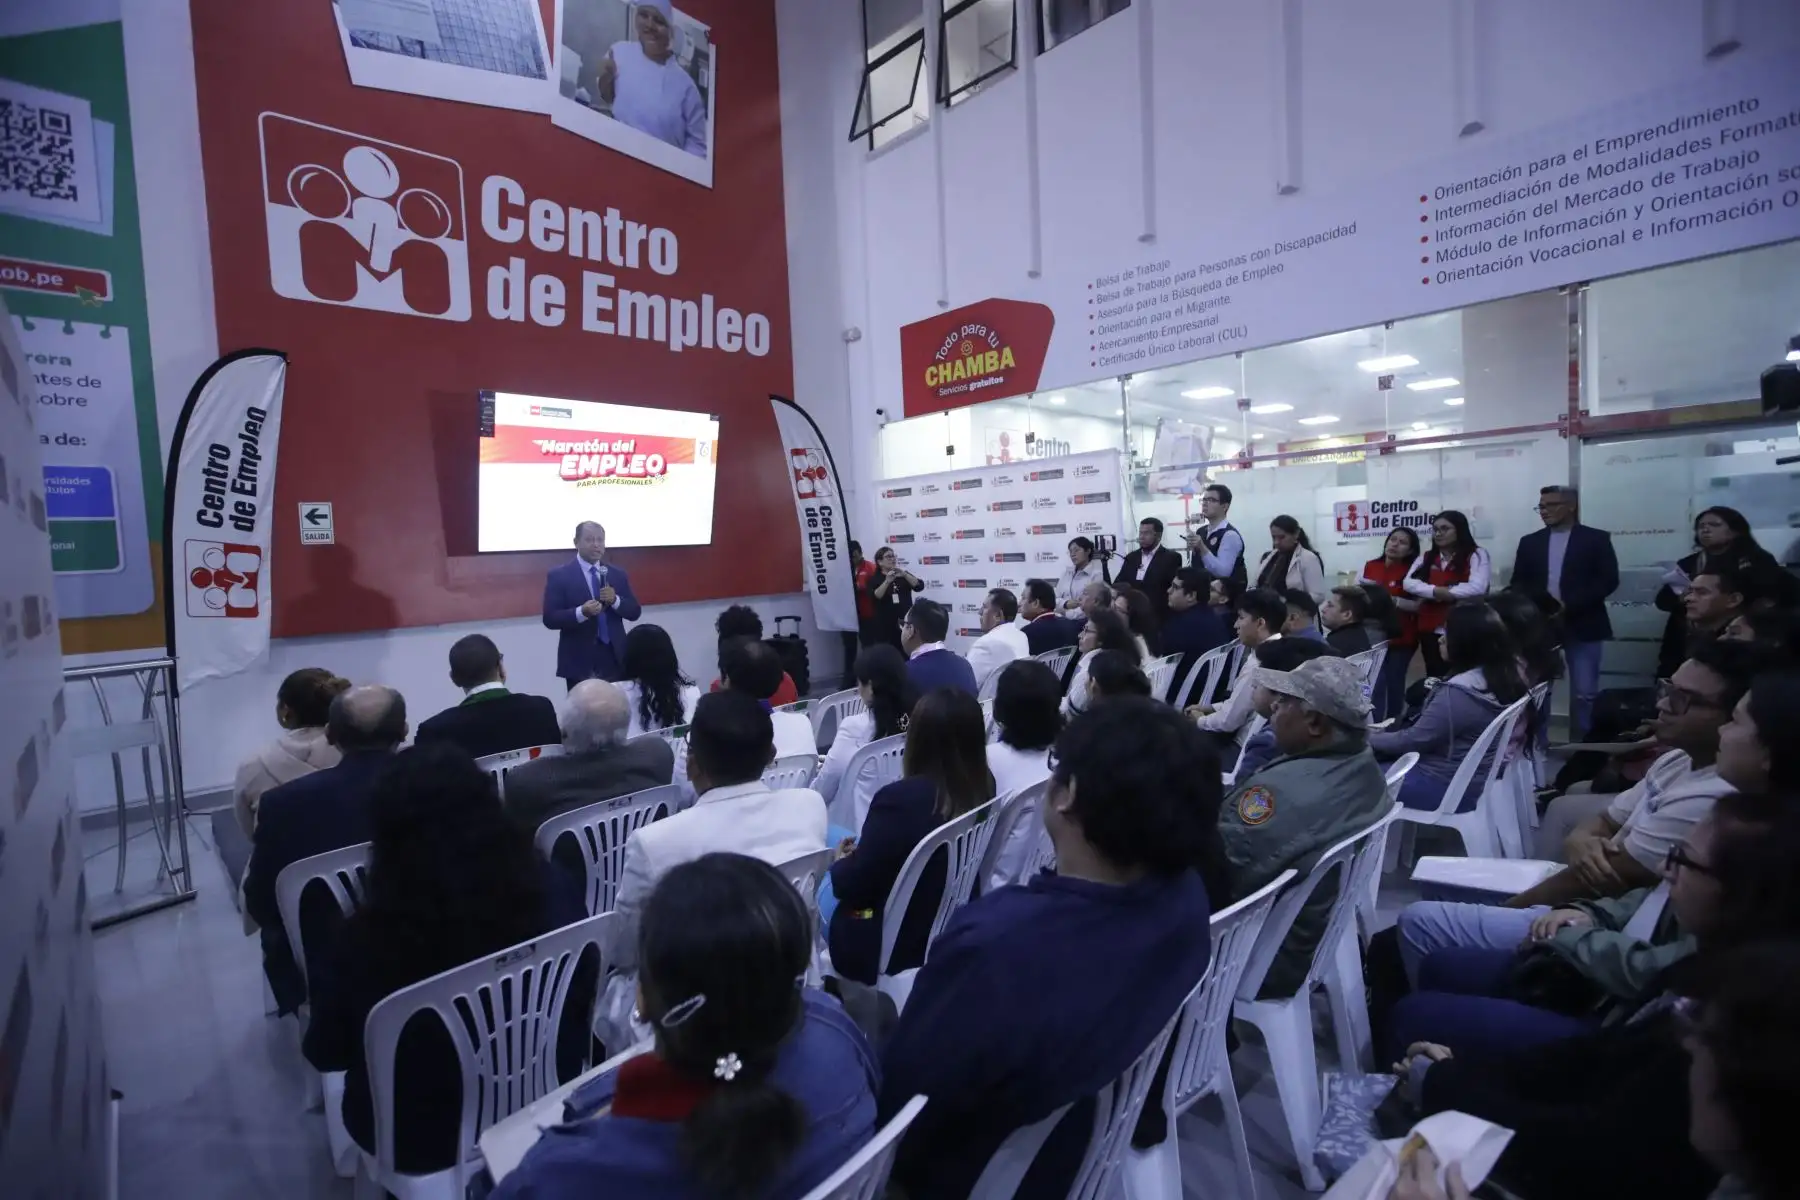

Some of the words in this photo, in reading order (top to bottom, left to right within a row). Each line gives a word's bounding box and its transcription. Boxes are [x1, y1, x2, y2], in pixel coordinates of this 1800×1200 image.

[1434, 165, 1523, 201] Orientación
[1528, 153, 1566, 177] para
[1573, 144, 1588, 159] el
[1595, 97, 1760, 155] Emprendimiento
[1435, 181, 1553, 222] Intermediación
[1558, 171, 1580, 187] de
[1586, 137, 1712, 180] Modalidades
[1436, 207, 1527, 243] Información
[1533, 199, 1559, 219] del
[1565, 179, 1644, 210] Mercado
[1651, 169, 1675, 188] de
[1681, 149, 1760, 180] Trabajo
[481, 175, 678, 276] Centro
[1436, 240, 1492, 264] Módulo
[1498, 232, 1518, 250] de
[1523, 206, 1627, 244] Información
[1633, 204, 1644, 221] y
[1651, 171, 1769, 213] Orientación
[1436, 254, 1524, 286] Orientación
[1530, 230, 1626, 264] Vocacional
[1632, 227, 1644, 241] e
[1651, 197, 1774, 239] Información
[0, 267, 64, 286] ob.pe
[1096, 290, 1120, 304] Bolsa
[1123, 285, 1135, 297] de
[1137, 275, 1171, 294] Trabajo
[1174, 270, 1196, 288] para
[1199, 253, 1247, 275] Personas
[1250, 247, 1271, 261] con
[1274, 221, 1357, 255] Discapacidad
[1096, 274, 1120, 289] Bolsa
[1123, 267, 1134, 281] de
[1136, 258, 1171, 278] Trabajo
[487, 256, 566, 327] de
[582, 270, 770, 357] Empleo
[1097, 301, 1134, 319] Asesoría
[1136, 297, 1157, 314] para
[1160, 292, 1169, 304] la
[1172, 278, 1222, 301] Búsqueda
[1225, 273, 1239, 287] de
[1242, 262, 1284, 284] Empleo
[1098, 314, 1148, 336] Orientación
[1150, 309, 1172, 326] para
[1174, 305, 1184, 317] el
[1187, 294, 1231, 316] Migrante
[1098, 329, 1159, 350] Acercamiento
[1161, 314, 1219, 339] Empresarial
[936, 332, 958, 361] Todo
[961, 323, 986, 339] para
[987, 330, 1000, 349] tu
[1099, 347, 1146, 367] Certificado
[1149, 339, 1175, 356] Único
[1178, 333, 1215, 350] Laboral
[1218, 325, 1248, 343] (CUL)
[25, 353, 72, 367] rera
[925, 345, 1016, 388] CHAMBA
[77, 375, 102, 388] de
[939, 383, 968, 396] Servicios
[969, 375, 1004, 391] gratuitos
[36, 393, 88, 407] obre
[55, 432, 87, 446] de:
[541, 438, 609, 454] Maratón
[611, 439, 636, 454] del
[45, 476, 92, 486] rsidades
[560, 454, 665, 477] EMPLEO
[196, 442, 231, 528] Centro
[577, 480, 597, 488] PARA
[598, 478, 653, 487] PROFESIONALES
[229, 500, 256, 532] de
[804, 507, 818, 528] de
[1371, 500, 1418, 513] Centro
[1372, 516, 1388, 528] de
[1392, 513, 1435, 528] Emple
[304, 532, 330, 540] SALIDA
[819, 505, 837, 561] Centro
